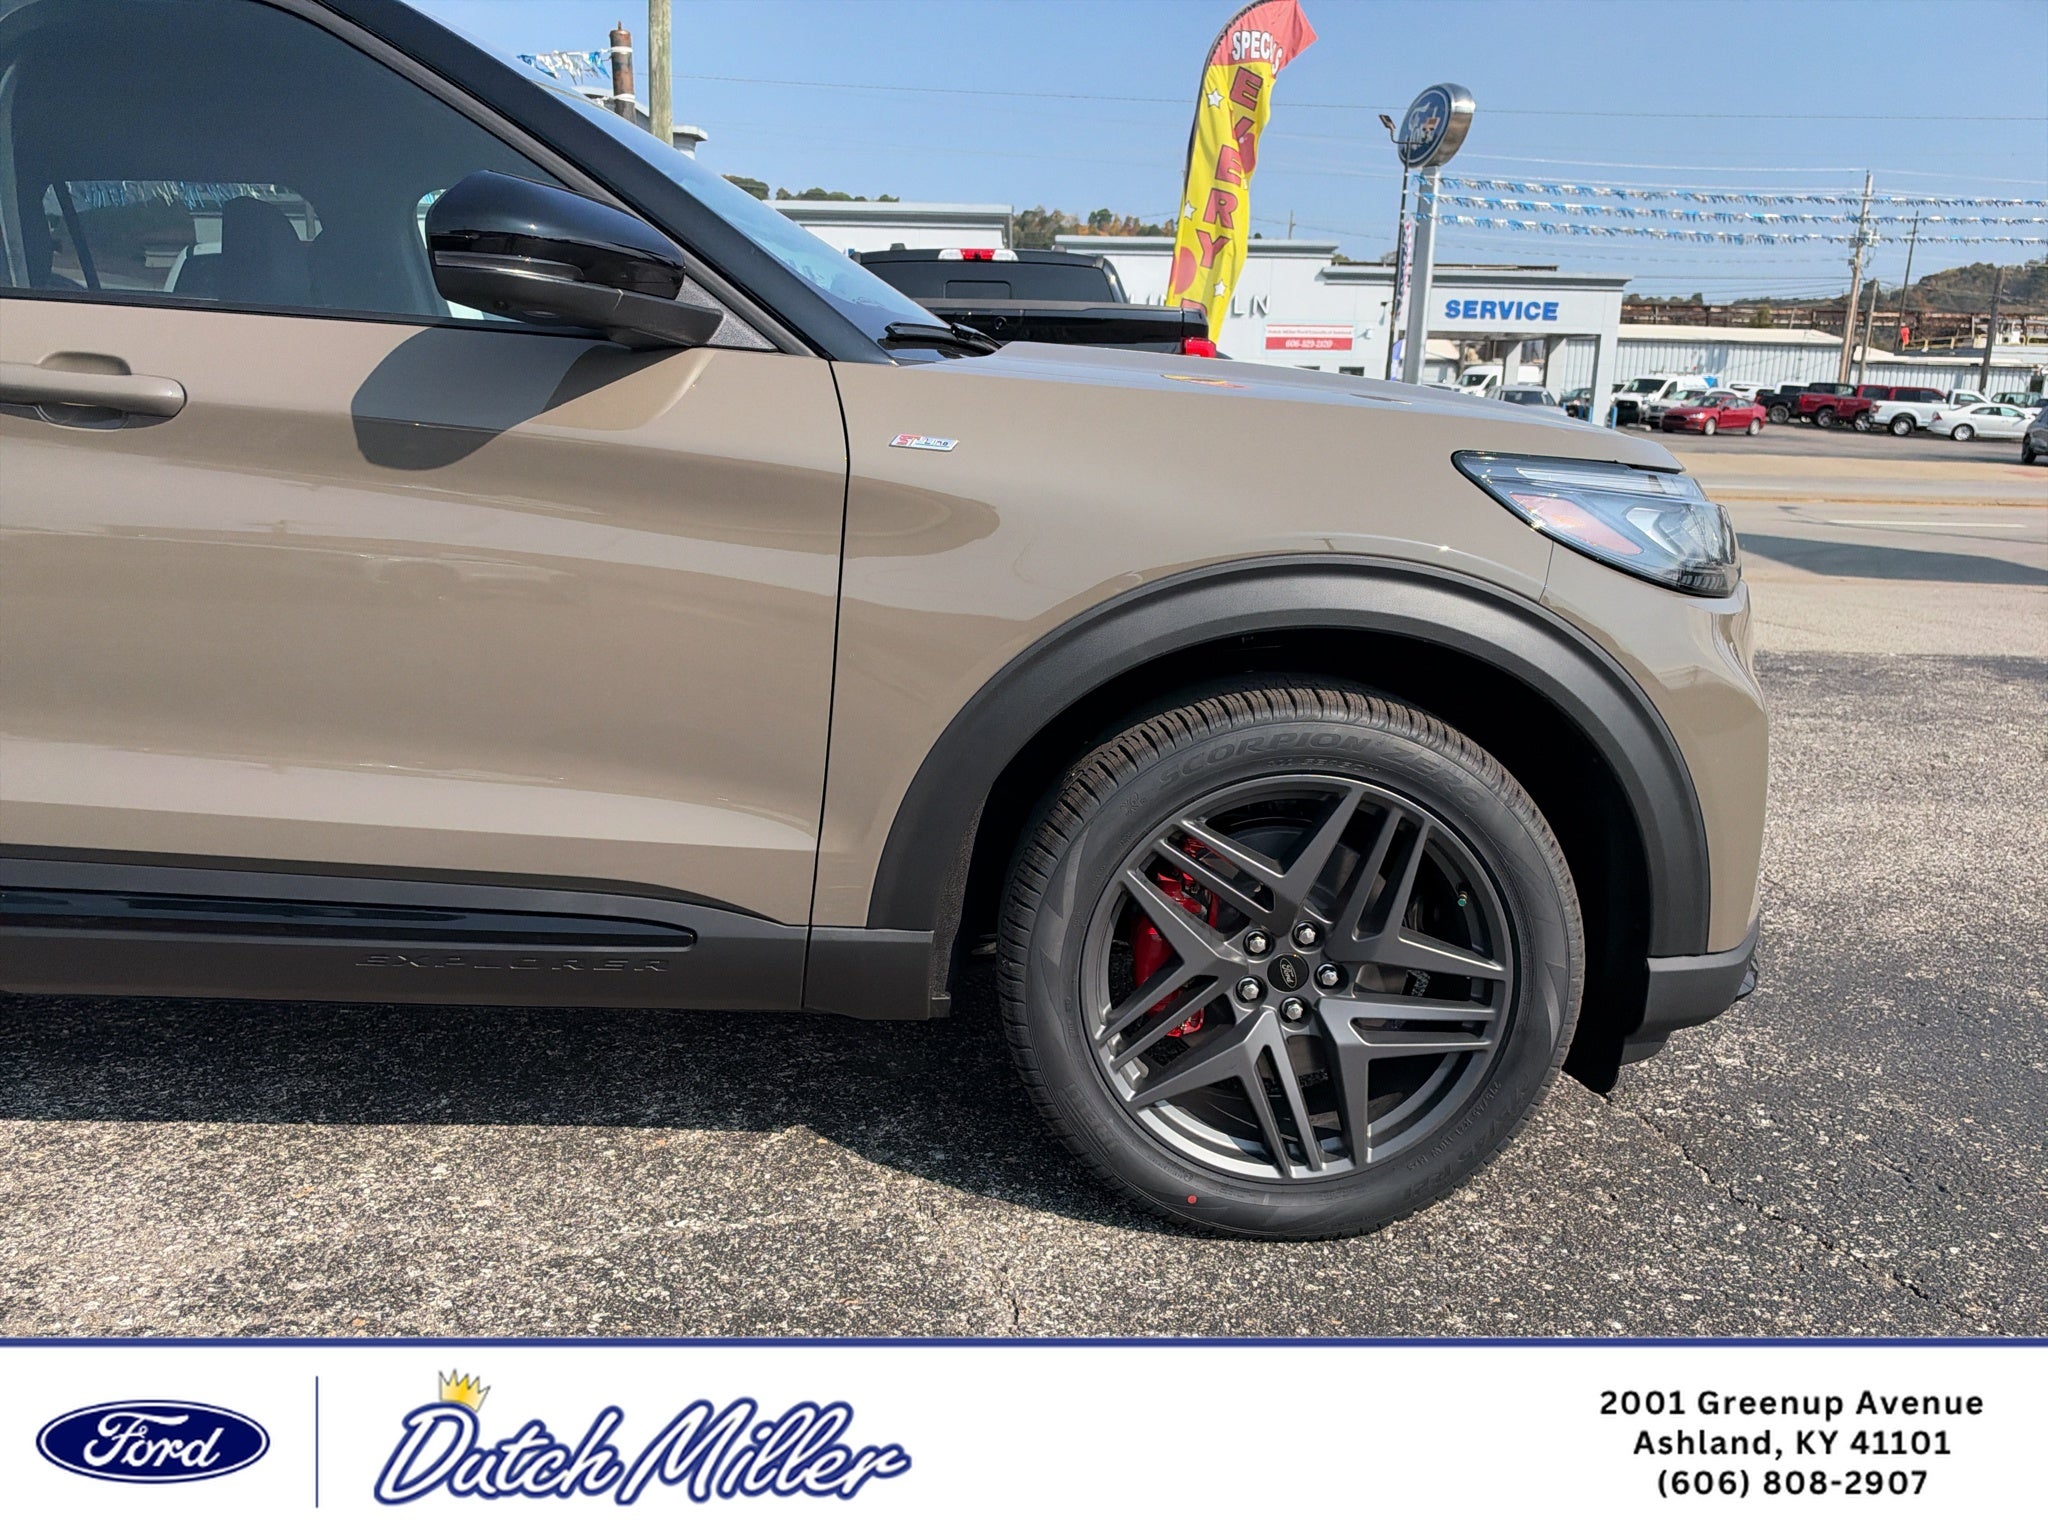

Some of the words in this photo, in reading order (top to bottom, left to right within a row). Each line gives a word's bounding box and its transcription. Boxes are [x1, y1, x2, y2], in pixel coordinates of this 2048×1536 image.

[1446, 299, 1559, 320] SERVICE
[1158, 731, 1371, 791] SCORPION
[1379, 746, 1483, 809] ZERO
[355, 954, 669, 973] EXPLORER
[1281, 964, 1296, 984] Ford
